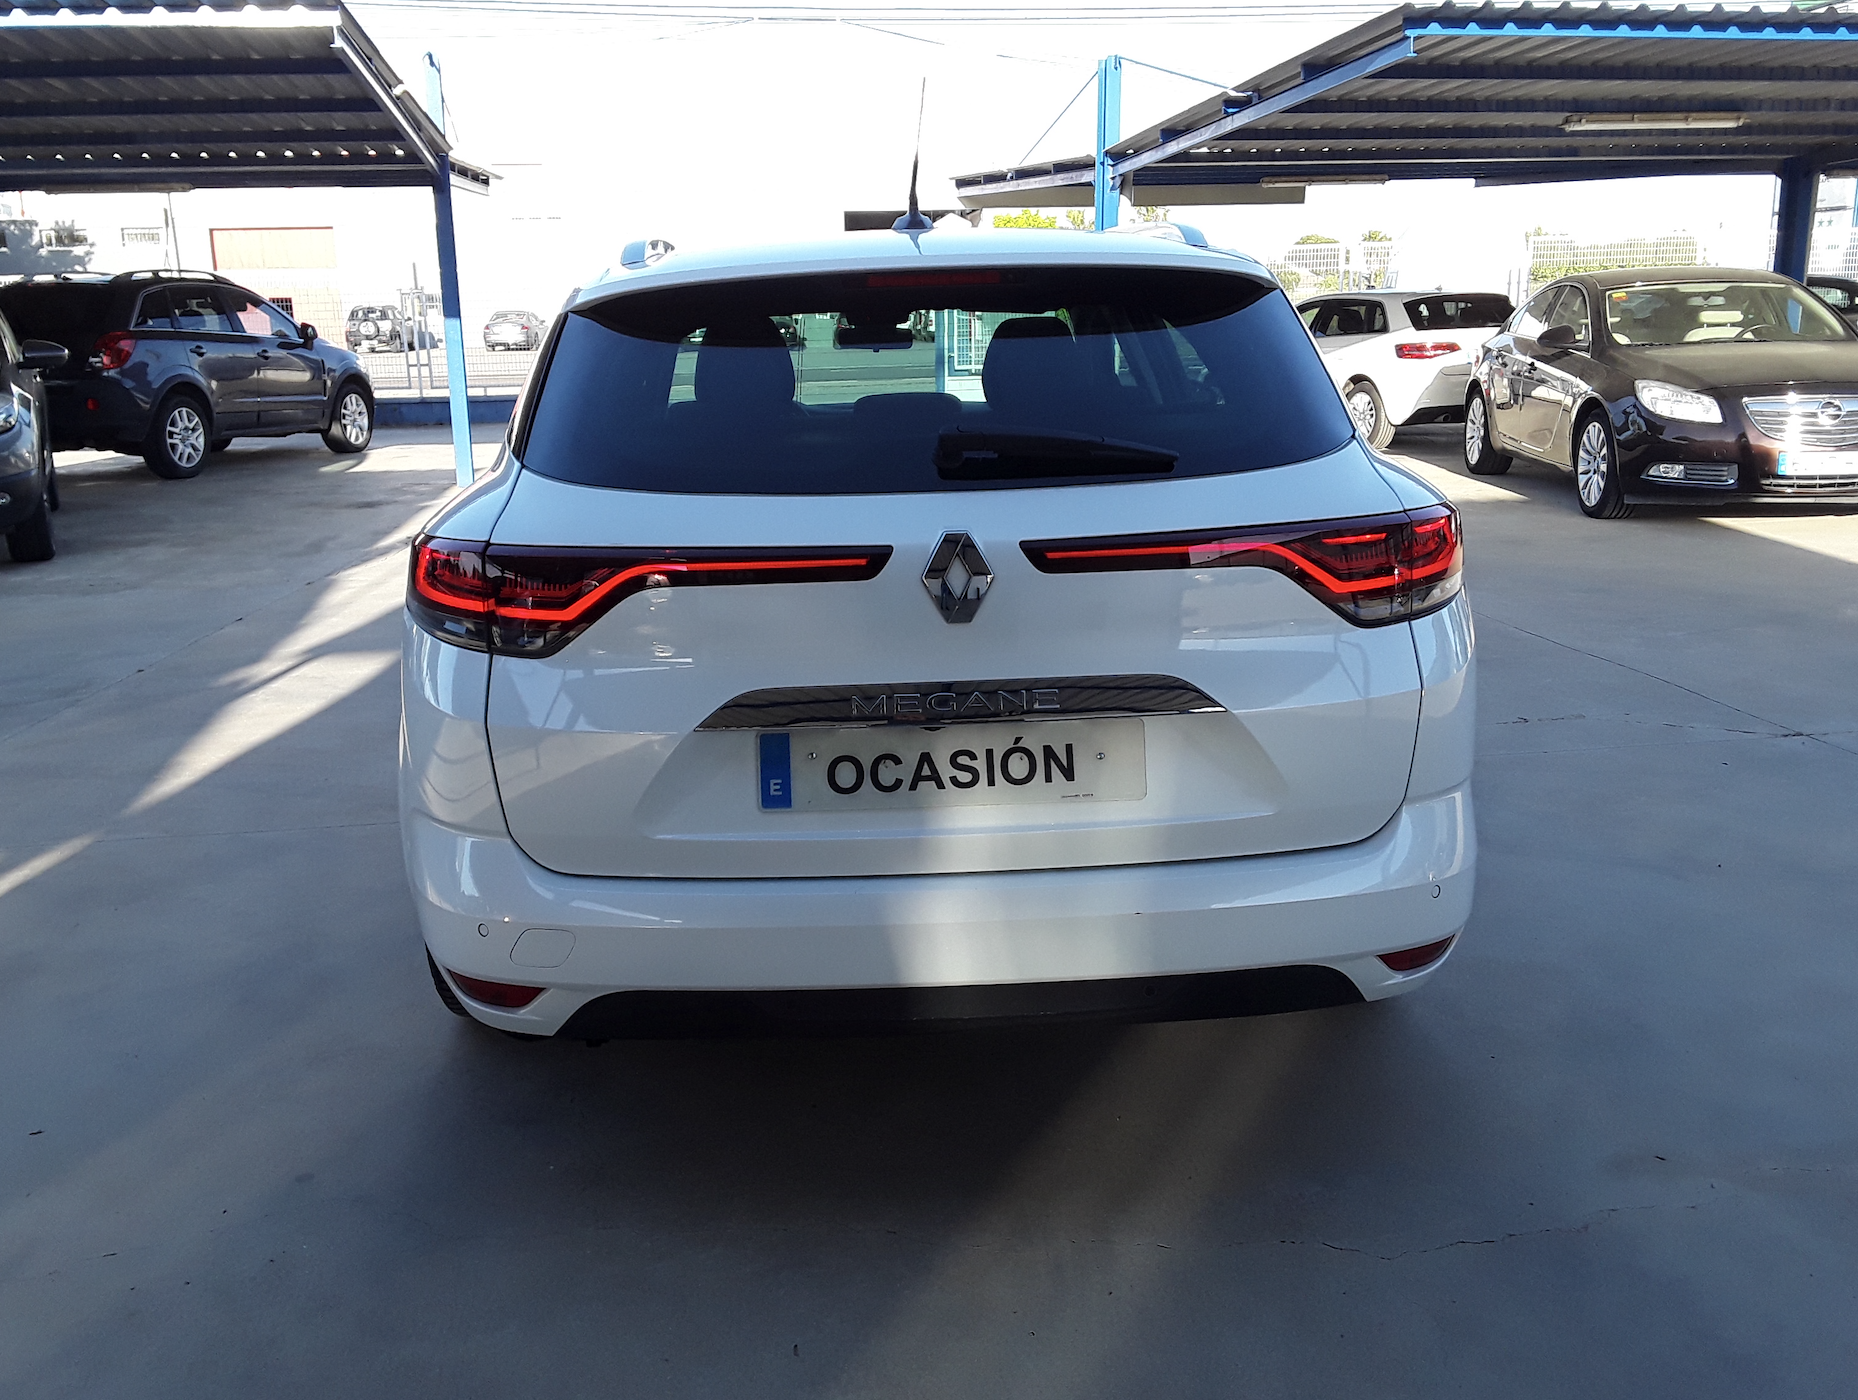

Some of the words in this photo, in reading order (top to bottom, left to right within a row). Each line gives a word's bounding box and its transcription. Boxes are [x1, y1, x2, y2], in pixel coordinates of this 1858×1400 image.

[851, 689, 1060, 715] MEGANE
[826, 736, 1076, 795] OCASIÓN
[769, 779, 782, 796] E
